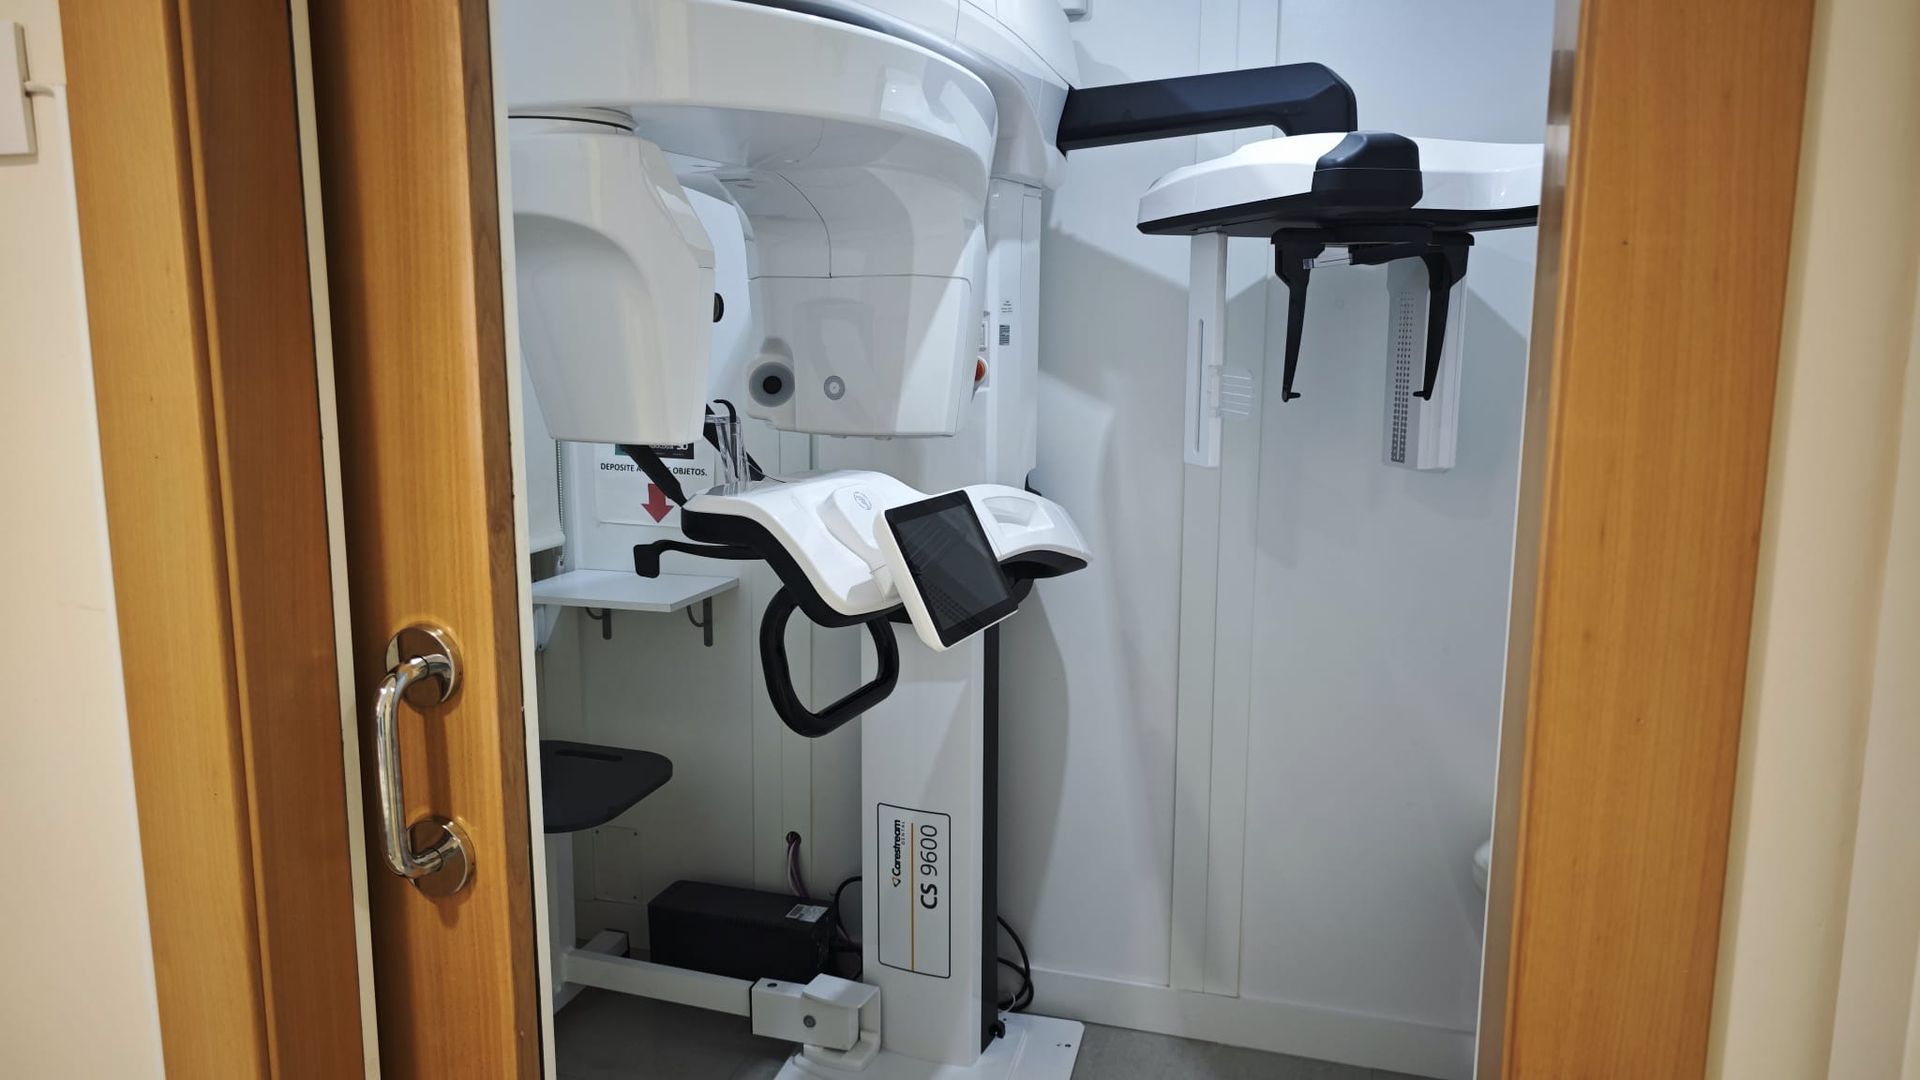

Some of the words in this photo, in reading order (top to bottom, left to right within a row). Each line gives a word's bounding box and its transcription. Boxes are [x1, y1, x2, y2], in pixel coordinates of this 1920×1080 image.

[600, 462, 635, 472] DEPOSITE
[672, 466, 708, 476] OBJETOS.
[892, 819, 901, 876] Carestream
[920, 824, 938, 876] 9600
[920, 883, 938, 909] CS
